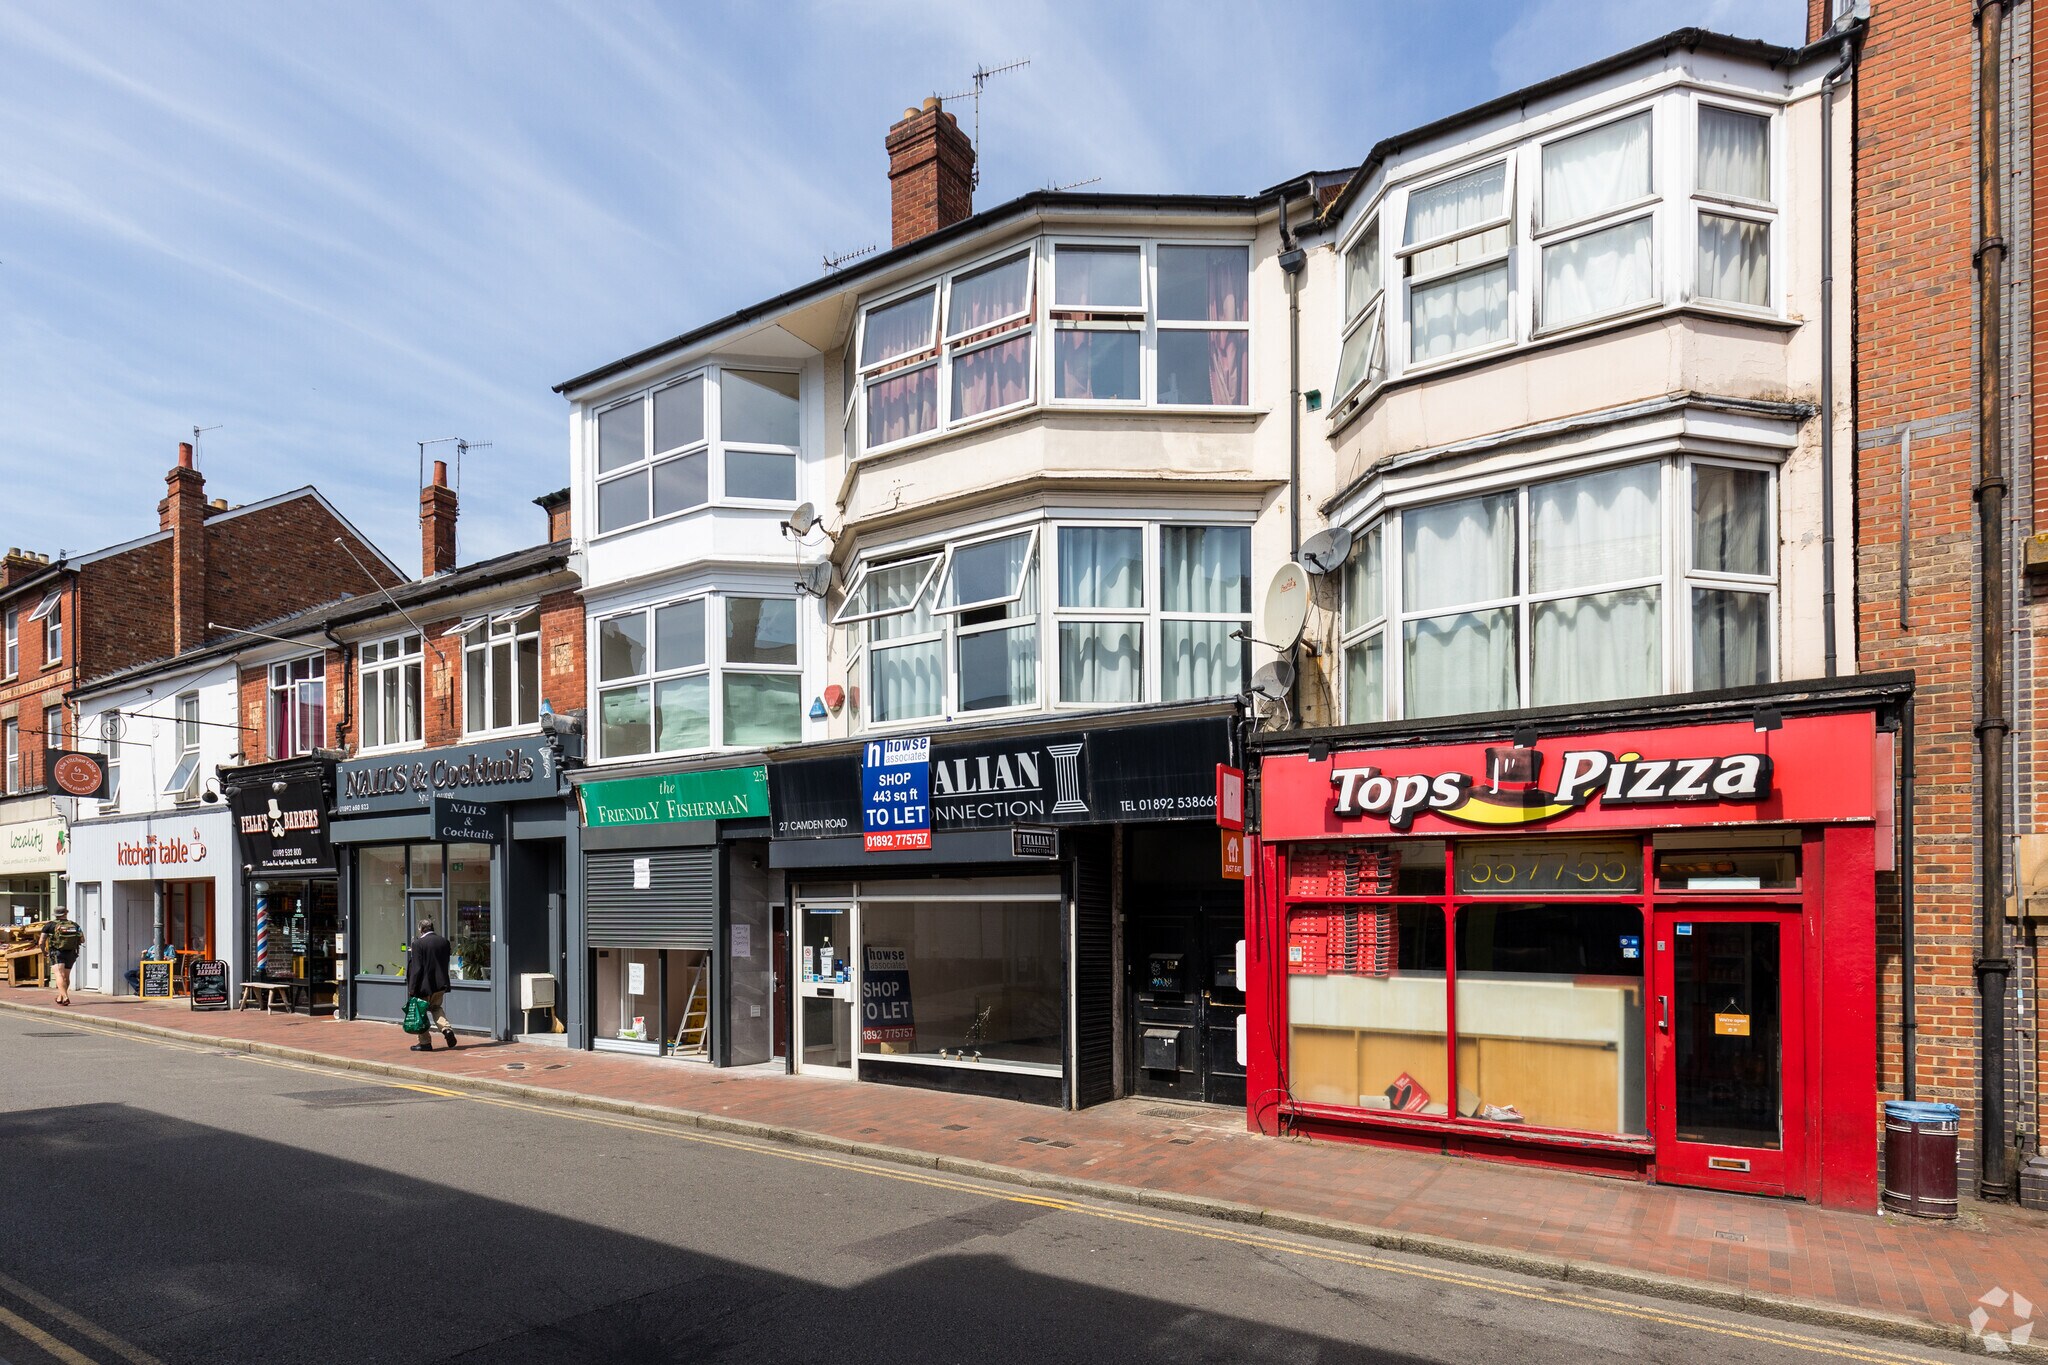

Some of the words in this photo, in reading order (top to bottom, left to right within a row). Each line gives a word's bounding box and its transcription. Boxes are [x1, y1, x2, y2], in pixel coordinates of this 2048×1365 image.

[886, 737, 927, 753] howse
[886, 751, 927, 764] associates
[344, 763, 408, 797] NAILS
[409, 762, 429, 790] &
[430, 748, 534, 788] Cocktails
[753, 770, 765, 782] 25
[879, 772, 911, 786] SHOP
[930, 751, 1040, 795] ALIAN
[659, 781, 676, 795] the
[1331, 765, 1464, 824] Tops
[1553, 750, 1761, 802] Pizza
[418, 791, 429, 804] Spa
[873, 790, 891, 803] 443
[893, 791, 907, 803] sq
[909, 788, 918, 800] ft
[450, 803, 487, 816] NAILS
[597, 801, 659, 824] FRIENDLY
[666, 794, 749, 819] FISHERMAN
[930, 800, 1045, 821] NNECTION
[1120, 800, 1136, 811] TEL
[1139, 797, 1174, 811] 01892
[241, 813, 269, 833] FELLA'S
[283, 809, 319, 830] BARBERS
[463, 817, 473, 826] &
[866, 808, 889, 826] TO
[894, 805, 926, 825] LET
[779, 822, 788, 831] 27
[790, 820, 824, 831] CAMDEN
[825, 818, 848, 829] ROAD
[11, 828, 43, 852] locality
[146, 835, 157, 844] THE
[443, 826, 494, 840] Cocktails
[1022, 834, 1050, 846] ITALIAN
[867, 835, 893, 848] 01892
[895, 833, 928, 846] 775757
[118, 840, 157, 866] kitchen
[159, 837, 188, 864] table
[1225, 864, 1234, 872] JUST
[1234, 864, 1242, 872] EAT
[869, 948, 905, 960] howse
[870, 961, 906, 970] associates
[863, 981, 900, 998] SHOP
[882, 1001, 909, 1019] LET
[885, 1028, 914, 1039] 775757
